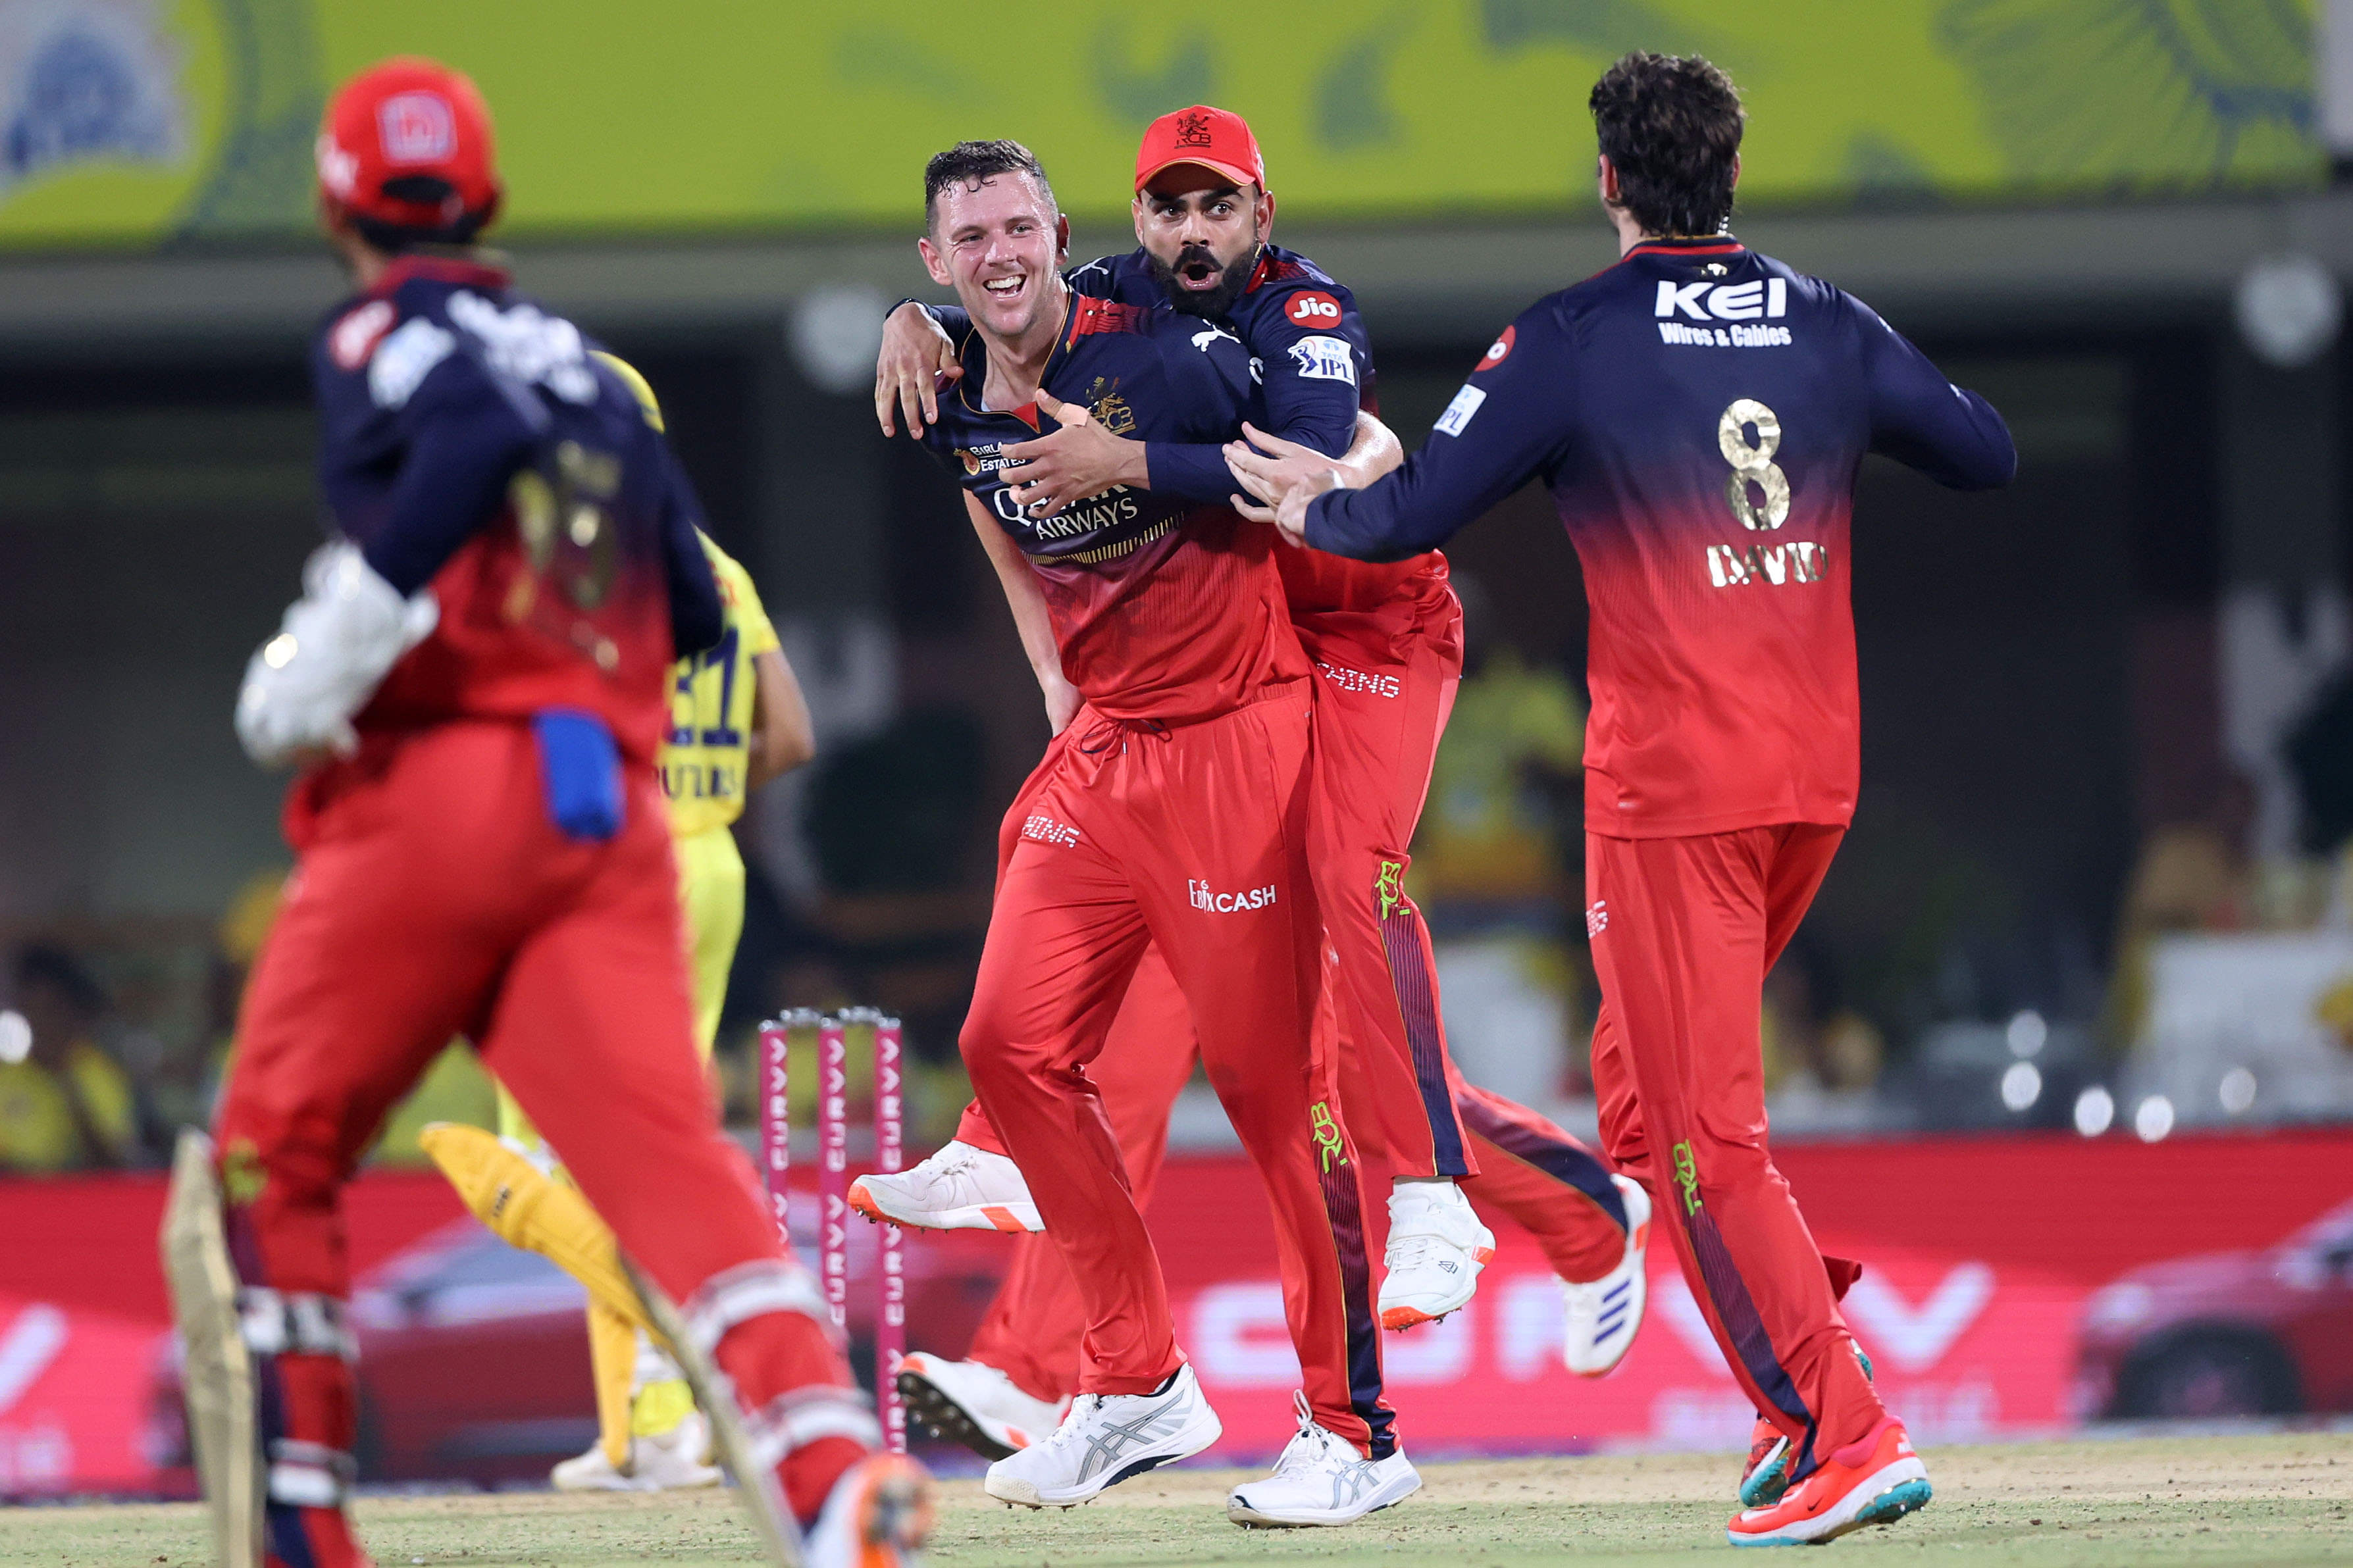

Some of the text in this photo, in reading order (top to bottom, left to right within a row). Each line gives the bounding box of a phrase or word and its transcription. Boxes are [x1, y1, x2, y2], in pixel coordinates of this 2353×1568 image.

[1293, 297, 1338, 318] Jio
[1654, 277, 1787, 321] KEI
[1658, 322, 1792, 347] Wires & Cables
[1321, 351, 1343, 361] TATA
[1321, 359, 1352, 381] IPL
[1439, 408, 1462, 431] PL
[1718, 399, 1790, 531] 8
[1036, 497, 1138, 540] AIRWAYS
[1707, 542, 1828, 588] DAVID
